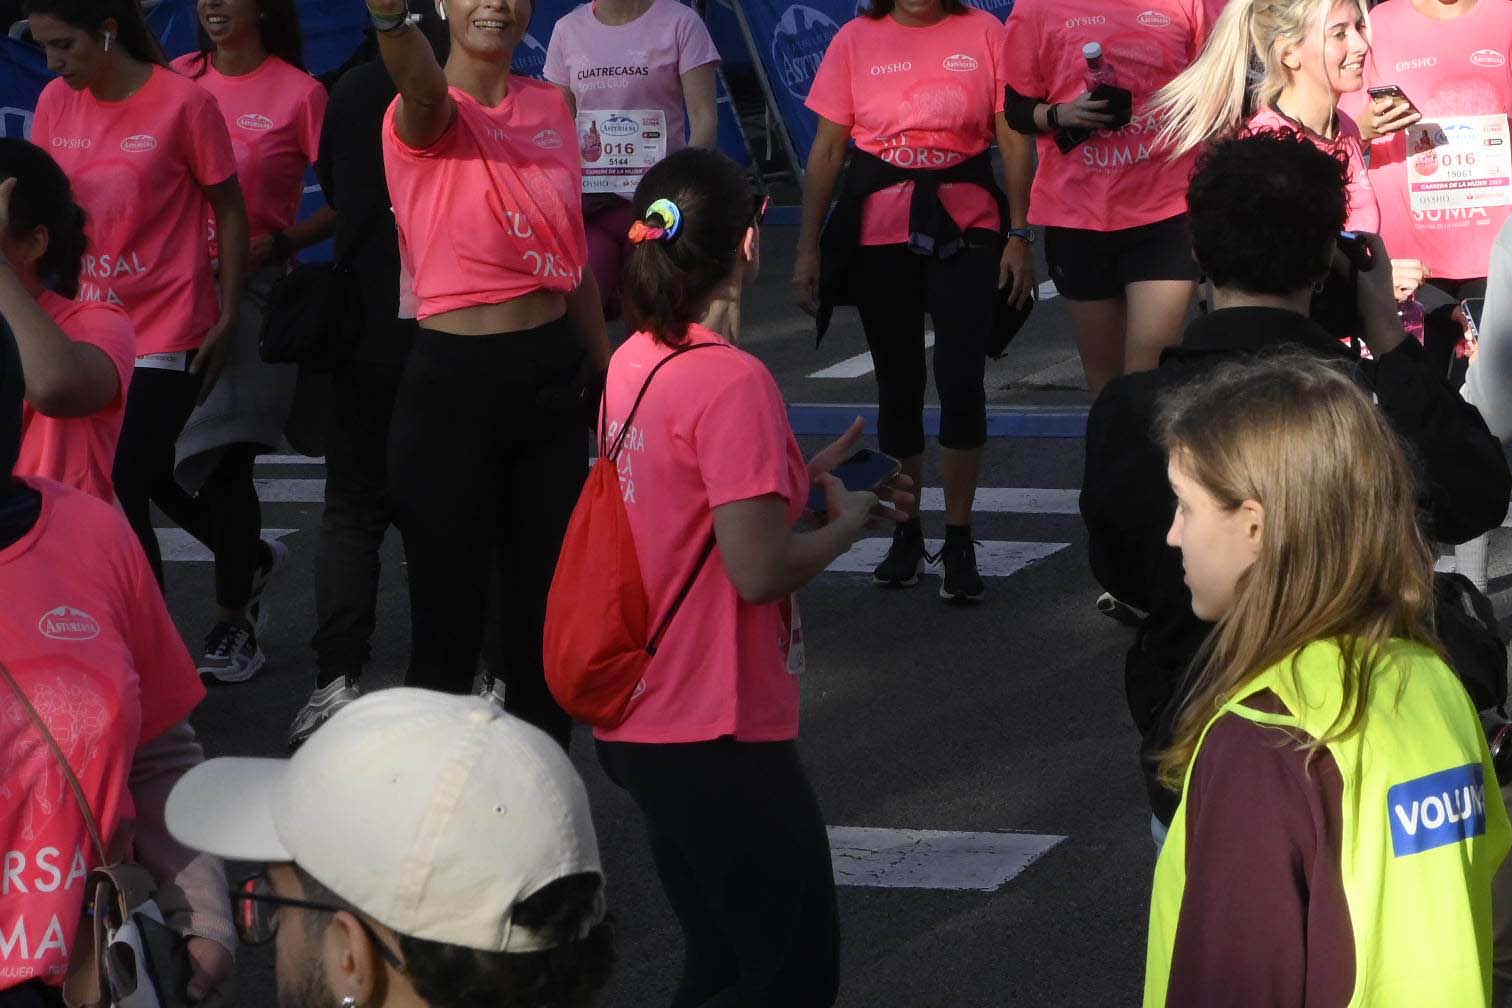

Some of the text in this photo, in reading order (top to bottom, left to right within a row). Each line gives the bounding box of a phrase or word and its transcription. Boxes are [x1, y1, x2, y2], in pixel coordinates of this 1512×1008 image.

[1065, 15, 1106, 29] OYSHO
[577, 66, 649, 80] CUATRECASAS
[870, 61, 912, 76] OYSHO
[52, 137, 91, 150] OYSHO
[604, 143, 635, 155] 016
[609, 158, 628, 166] 5144
[1083, 143, 1150, 168] SUMA
[1442, 152, 1476, 167] 016
[80, 251, 147, 279] RSAL
